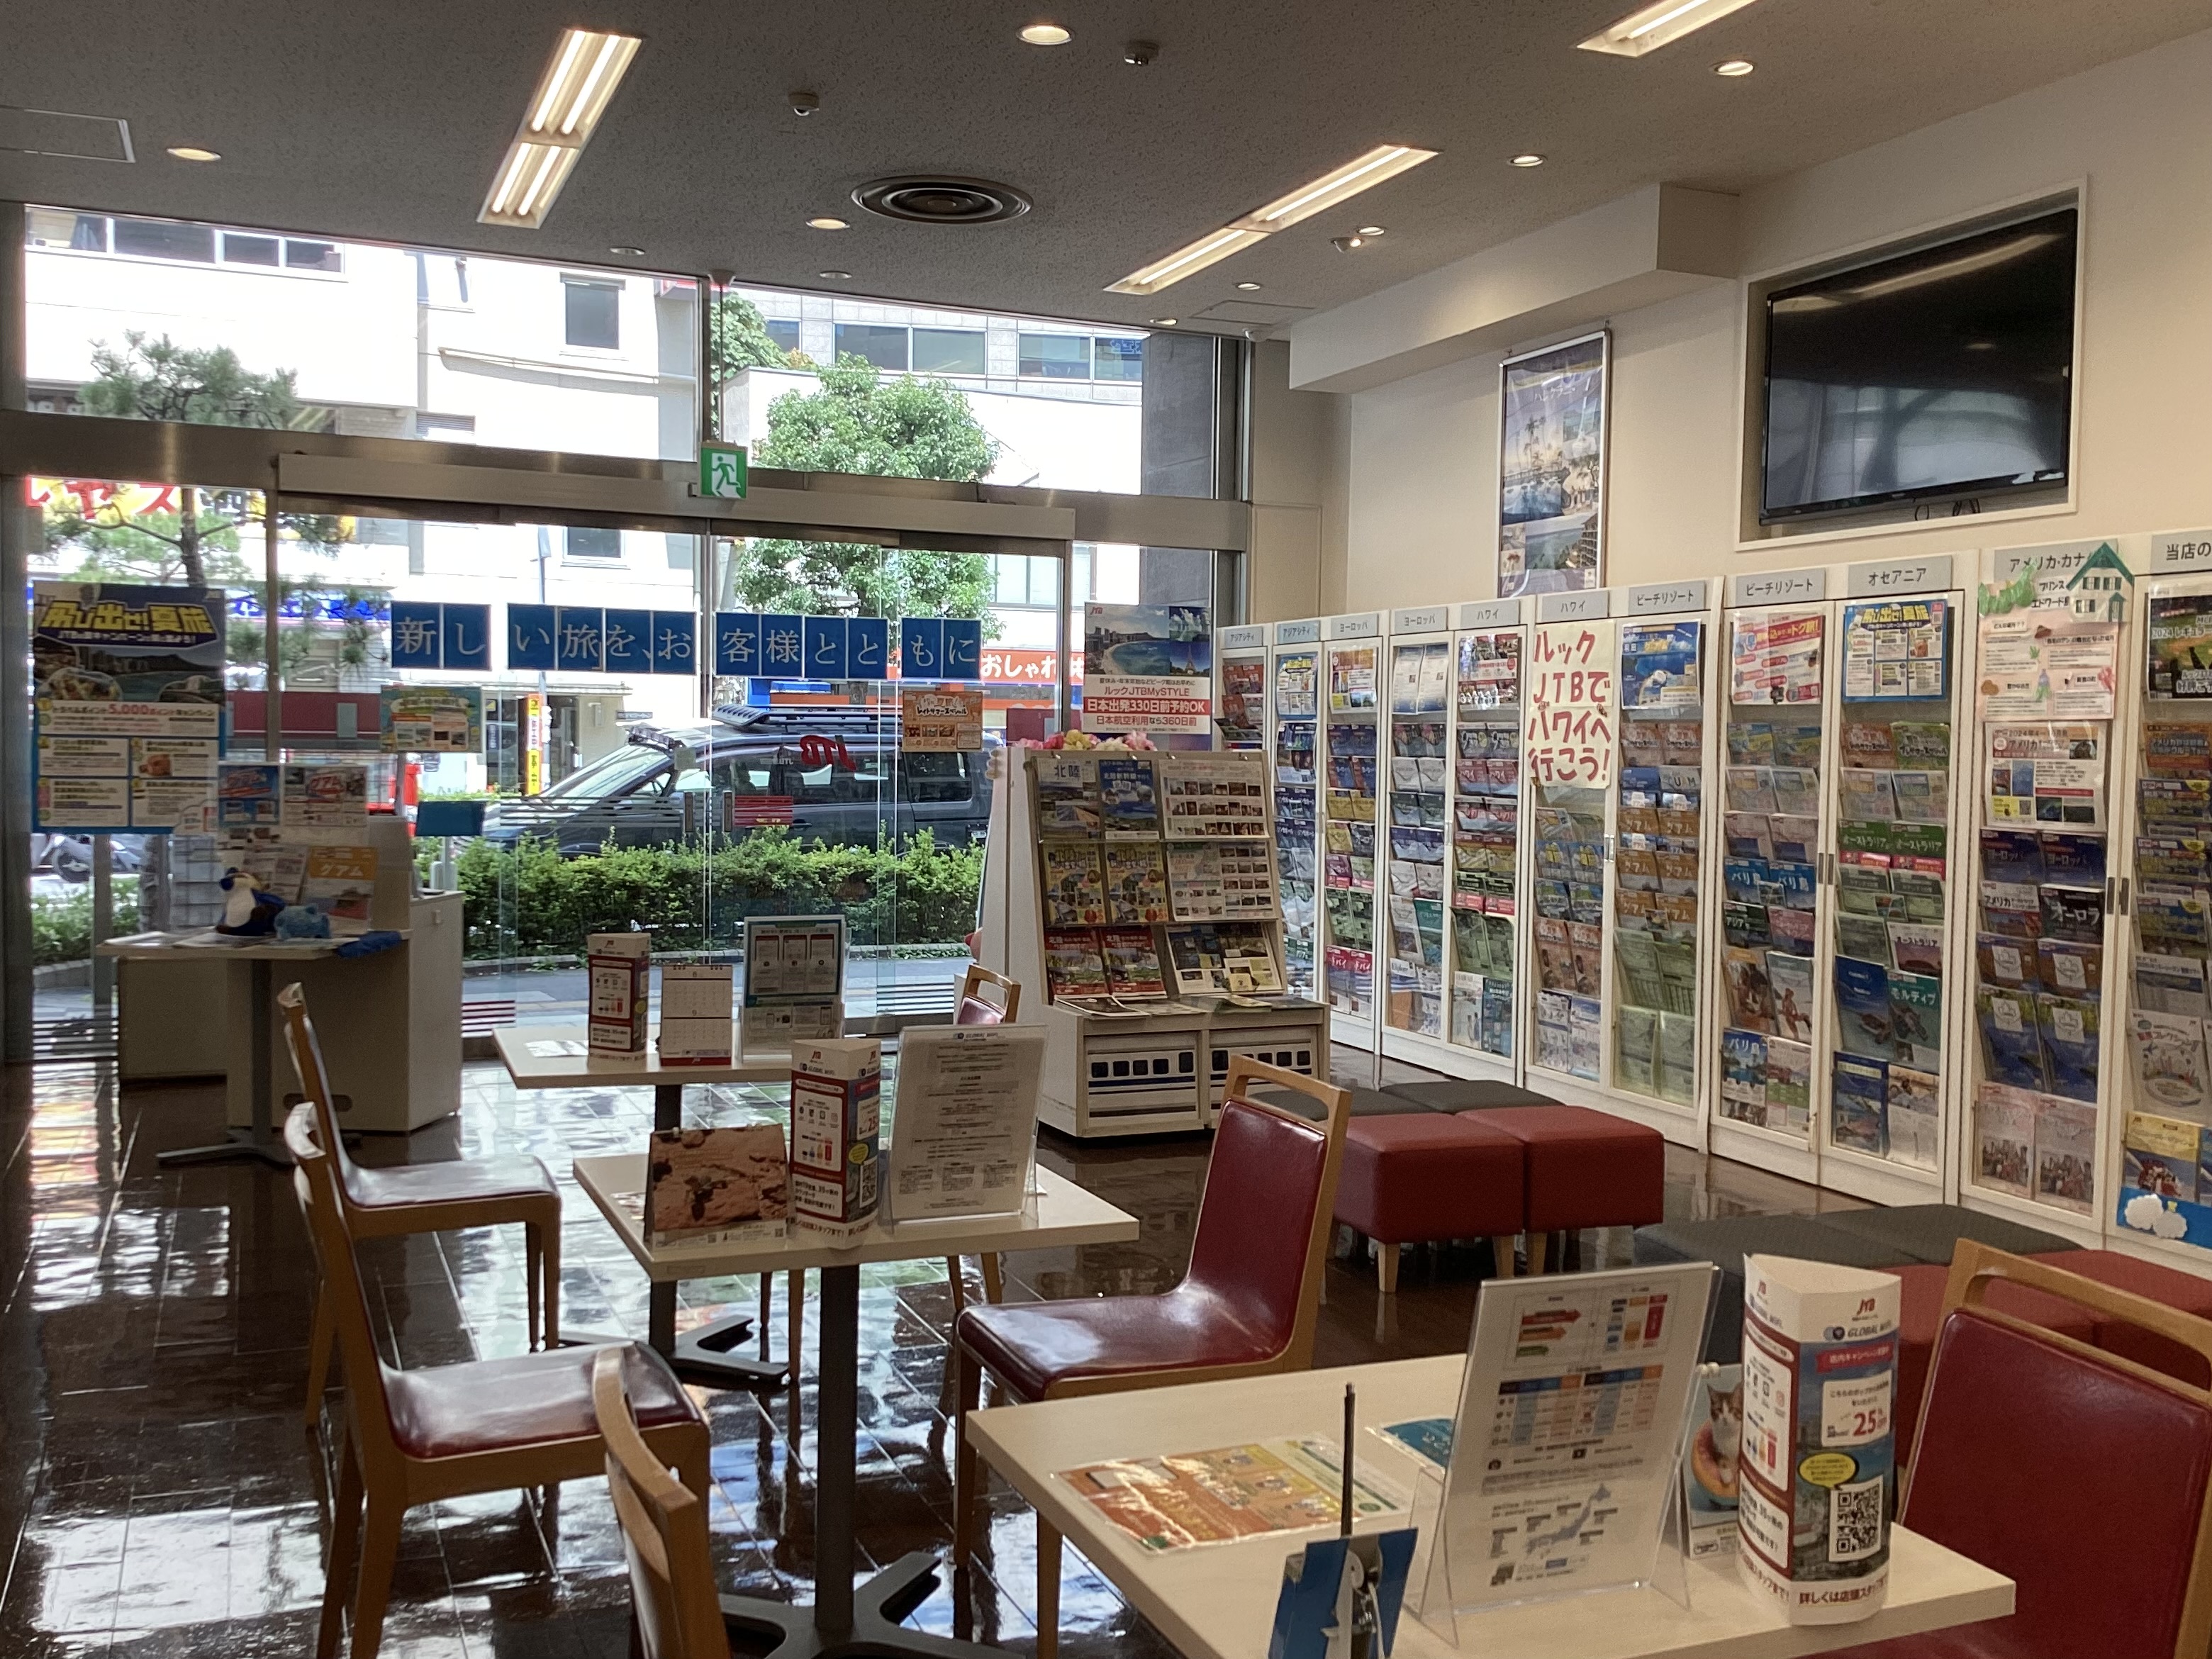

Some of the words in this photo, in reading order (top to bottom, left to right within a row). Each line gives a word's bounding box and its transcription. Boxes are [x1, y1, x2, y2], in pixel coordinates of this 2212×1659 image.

[2010, 552, 2091, 572] アメリカ・カナ
[1868, 568, 1927, 585] オセアニア
[1745, 579, 1814, 596] ビーチリゾート
[1636, 590, 1695, 606] ビーチリゾート
[1477, 608, 1499, 620] ハワイ
[1560, 601, 1586, 613] ハワイ
[1340, 622, 1368, 632] ヨーロッパ
[1403, 613, 1436, 625] ヨーロッパ
[1534, 630, 1596, 664] ルック
[1534, 671, 1611, 703] JTBで
[1087, 698, 1205, 714] 日本出発330日前予約OK
[1097, 715, 1197, 727] 日本航空利用なら360日前
[1529, 710, 1612, 744] ハワイへ
[1054, 764, 1081, 778] 北陸
[1527, 747, 1611, 782] 行こう!
[320, 863, 364, 877] グアム
[1856, 1297, 1876, 1316] JTB
